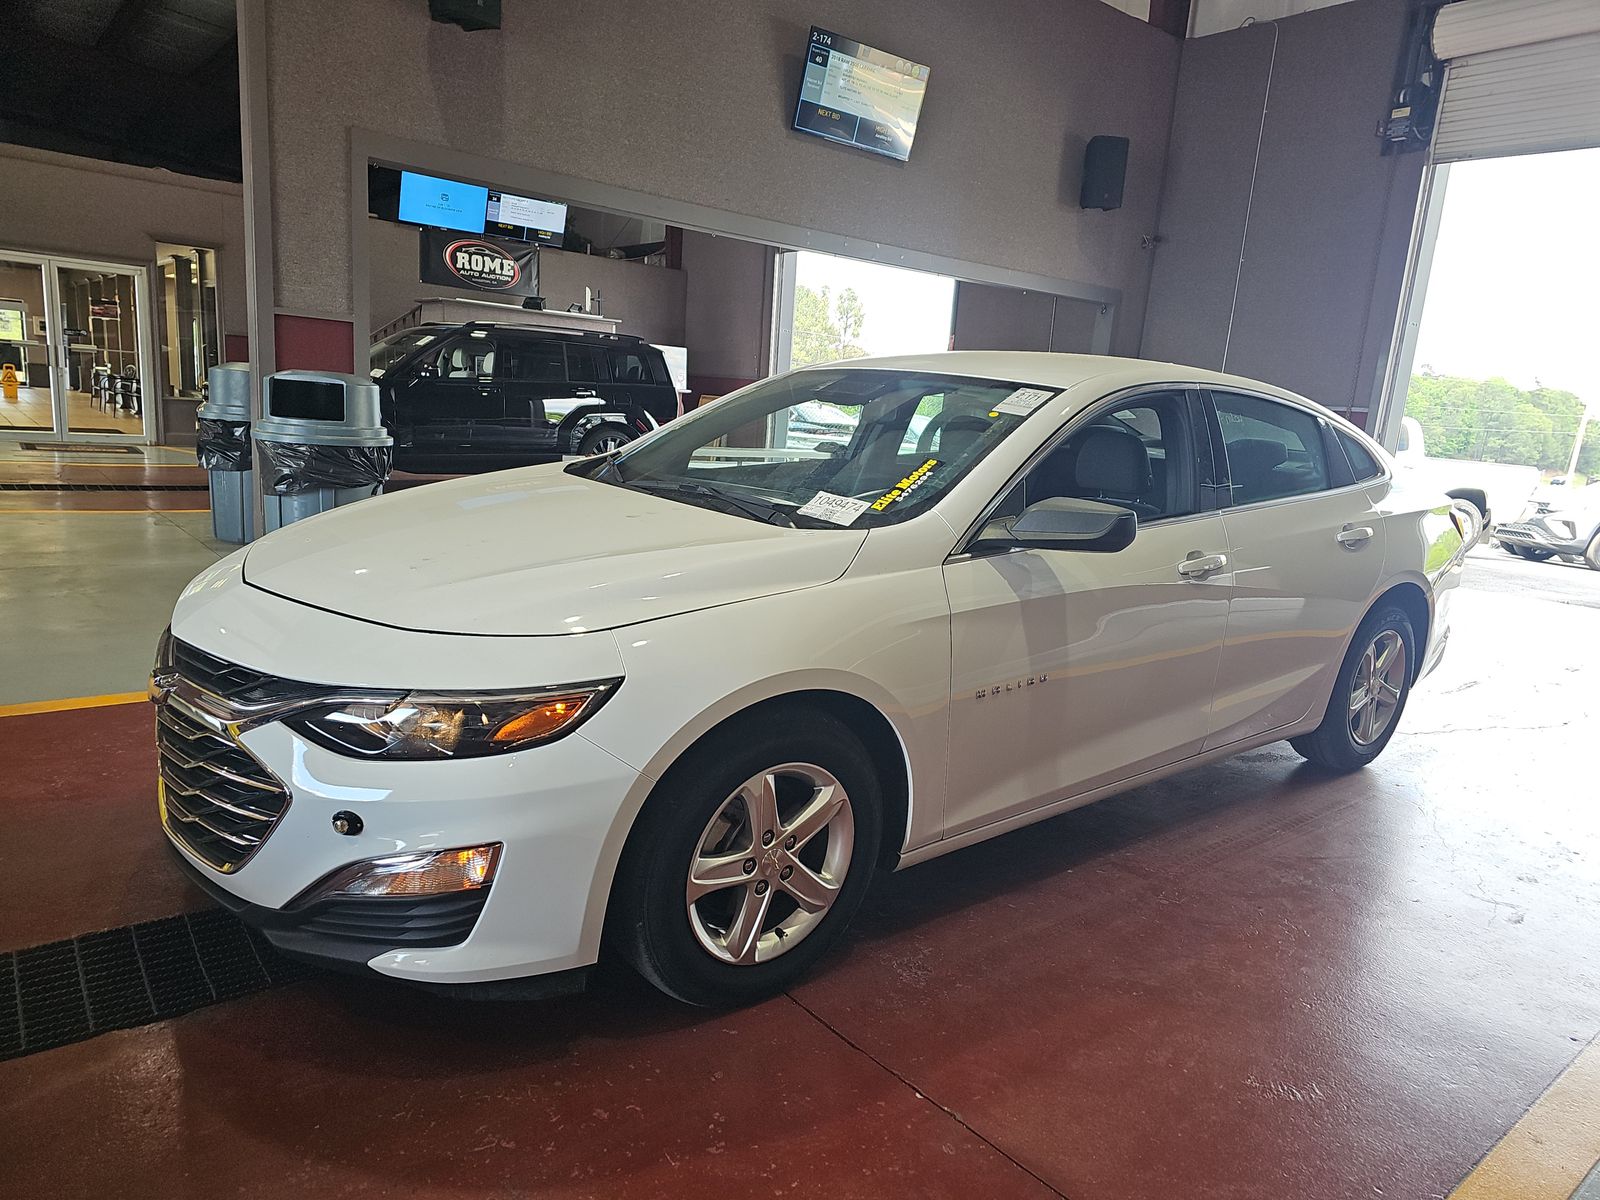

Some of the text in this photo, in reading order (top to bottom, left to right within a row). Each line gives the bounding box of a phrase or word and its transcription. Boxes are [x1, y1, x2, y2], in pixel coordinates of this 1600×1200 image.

[812, 32, 832, 45] 2-174
[815, 56, 822, 64] 40
[817, 108, 841, 120] NEXT BID
[456, 252, 514, 276] ROME
[481, 272, 512, 282] AUCTION
[870, 459, 938, 511] Elite Motors
[814, 495, 864, 512] 1049474
